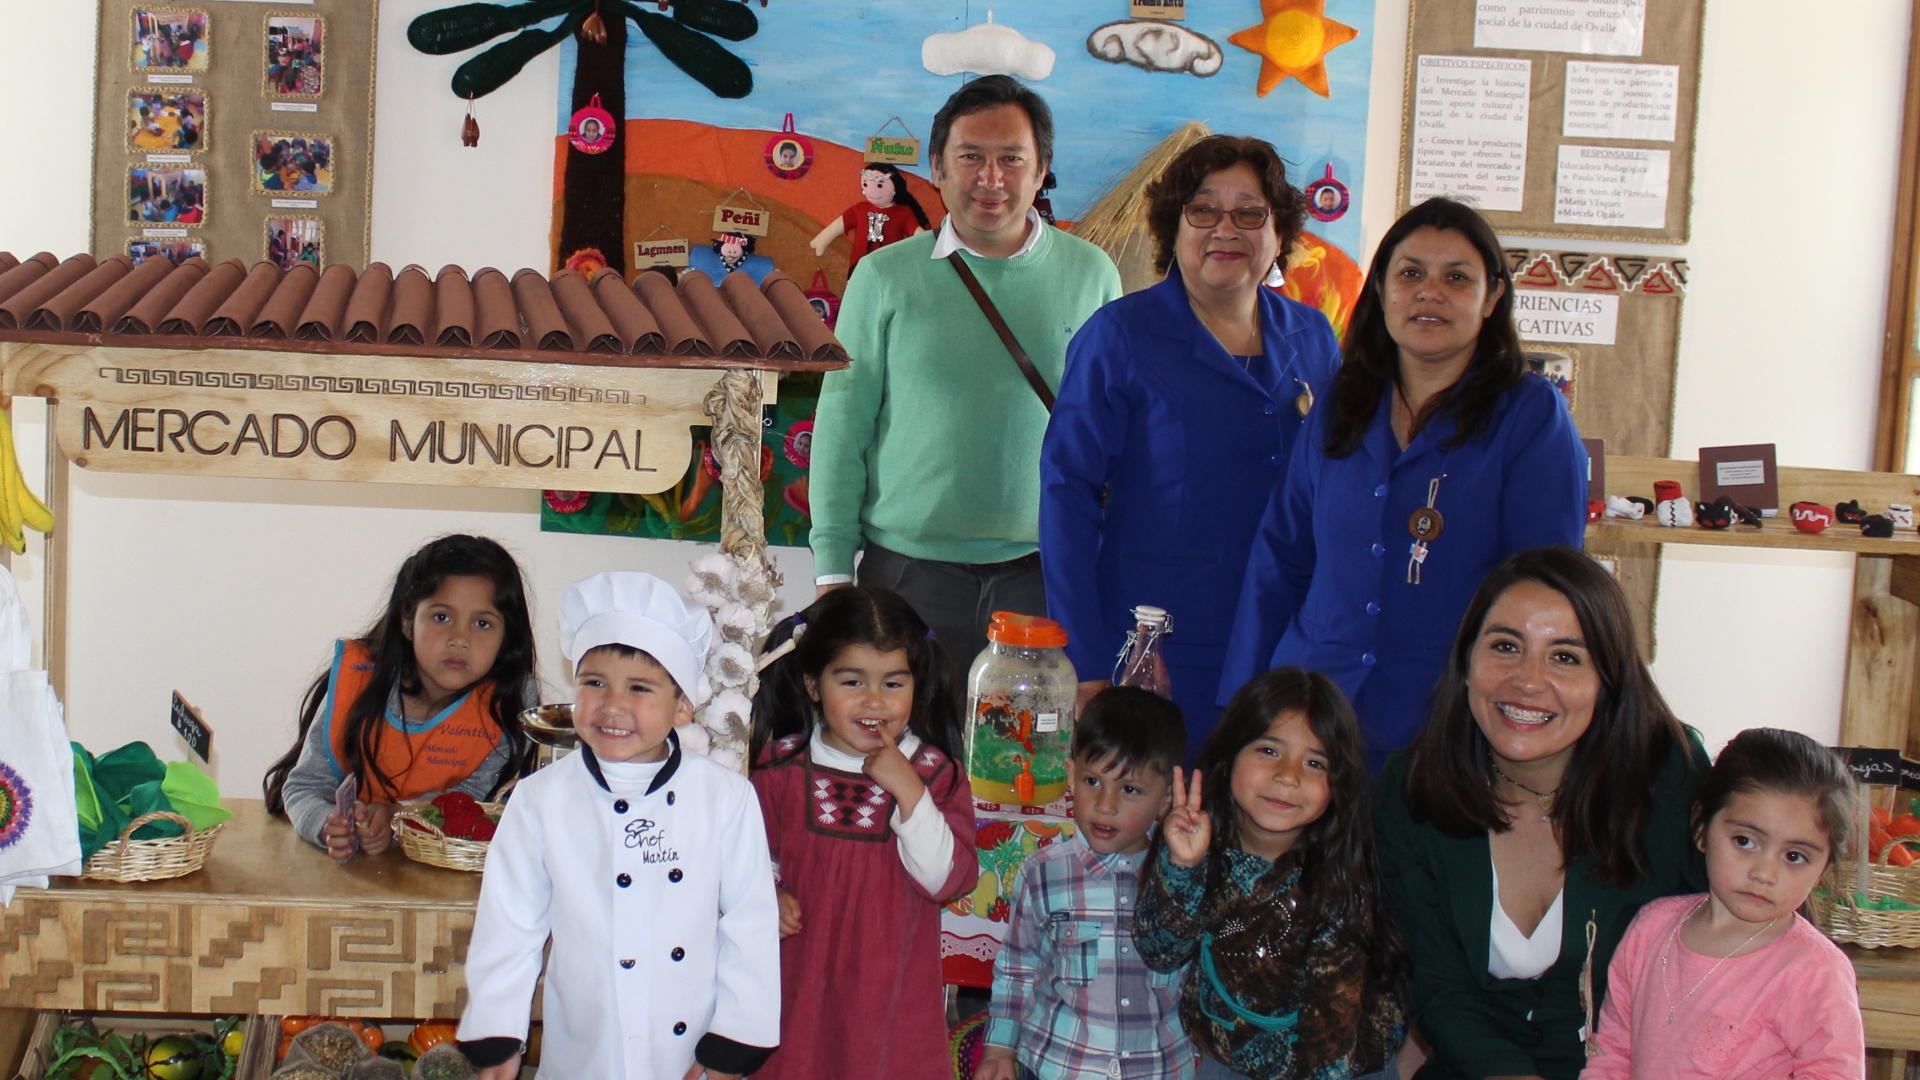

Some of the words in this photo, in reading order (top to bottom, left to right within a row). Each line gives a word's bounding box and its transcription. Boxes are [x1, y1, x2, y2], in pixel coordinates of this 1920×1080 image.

[1519, 6, 1575, 17] patrimonio
[1587, 9, 1626, 19] cultural
[1478, 17, 1505, 27] social
[1508, 18, 1520, 28] de
[1523, 19, 1532, 28] la
[1534, 20, 1568, 30] ciudad
[1571, 21, 1582, 31] de
[1420, 58, 1468, 68] OBJETIVOS
[1585, 64, 1632, 75] Representar
[1436, 76, 1476, 87] Investigar
[1481, 78, 1489, 86] la
[1496, 78, 1526, 88] historia
[1421, 86, 1433, 95] del
[1441, 87, 1477, 97] Mercado
[1485, 89, 1526, 100] Municipal
[1603, 88, 1613, 96] de
[1449, 101, 1475, 109] aporte
[1481, 101, 1513, 110] cultural
[1600, 99, 1609, 107] de
[1613, 101, 1653, 110] productos
[1420, 109, 1443, 118] social
[1449, 110, 1458, 119] de
[1466, 111, 1474, 119] la
[1480, 112, 1507, 120] ciudad
[1513, 113, 1523, 121] de
[1431, 136, 1465, 146] Conocer
[1467, 138, 1480, 146] los
[1481, 139, 1523, 149] productos
[1451, 150, 1467, 159] que
[1473, 149, 1504, 159] ofrecen
[1510, 151, 1521, 160] los
[1417, 159, 1456, 168] locatarios
[1459, 160, 1472, 169] del
[1476, 161, 1512, 171] mercado
[1560, 161, 1601, 171] Educadora
[1416, 169, 1428, 177] los
[1435, 171, 1468, 179] usuarios
[1476, 172, 1488, 180] del
[1495, 174, 1520, 182] sector
[1572, 173, 1594, 182] Paula
[1416, 181, 1435, 189] rural
[1611, 188, 1622, 197] de
[721, 208, 760, 226] Peñi
[1564, 208, 1595, 218] Marcela
[83, 406, 357, 461] MERCADO
[389, 419, 658, 472] MUNICIPAL
[440, 725, 497, 740] Valentina
[624, 830, 665, 852] Chef
[643, 848, 680, 864] Martín
